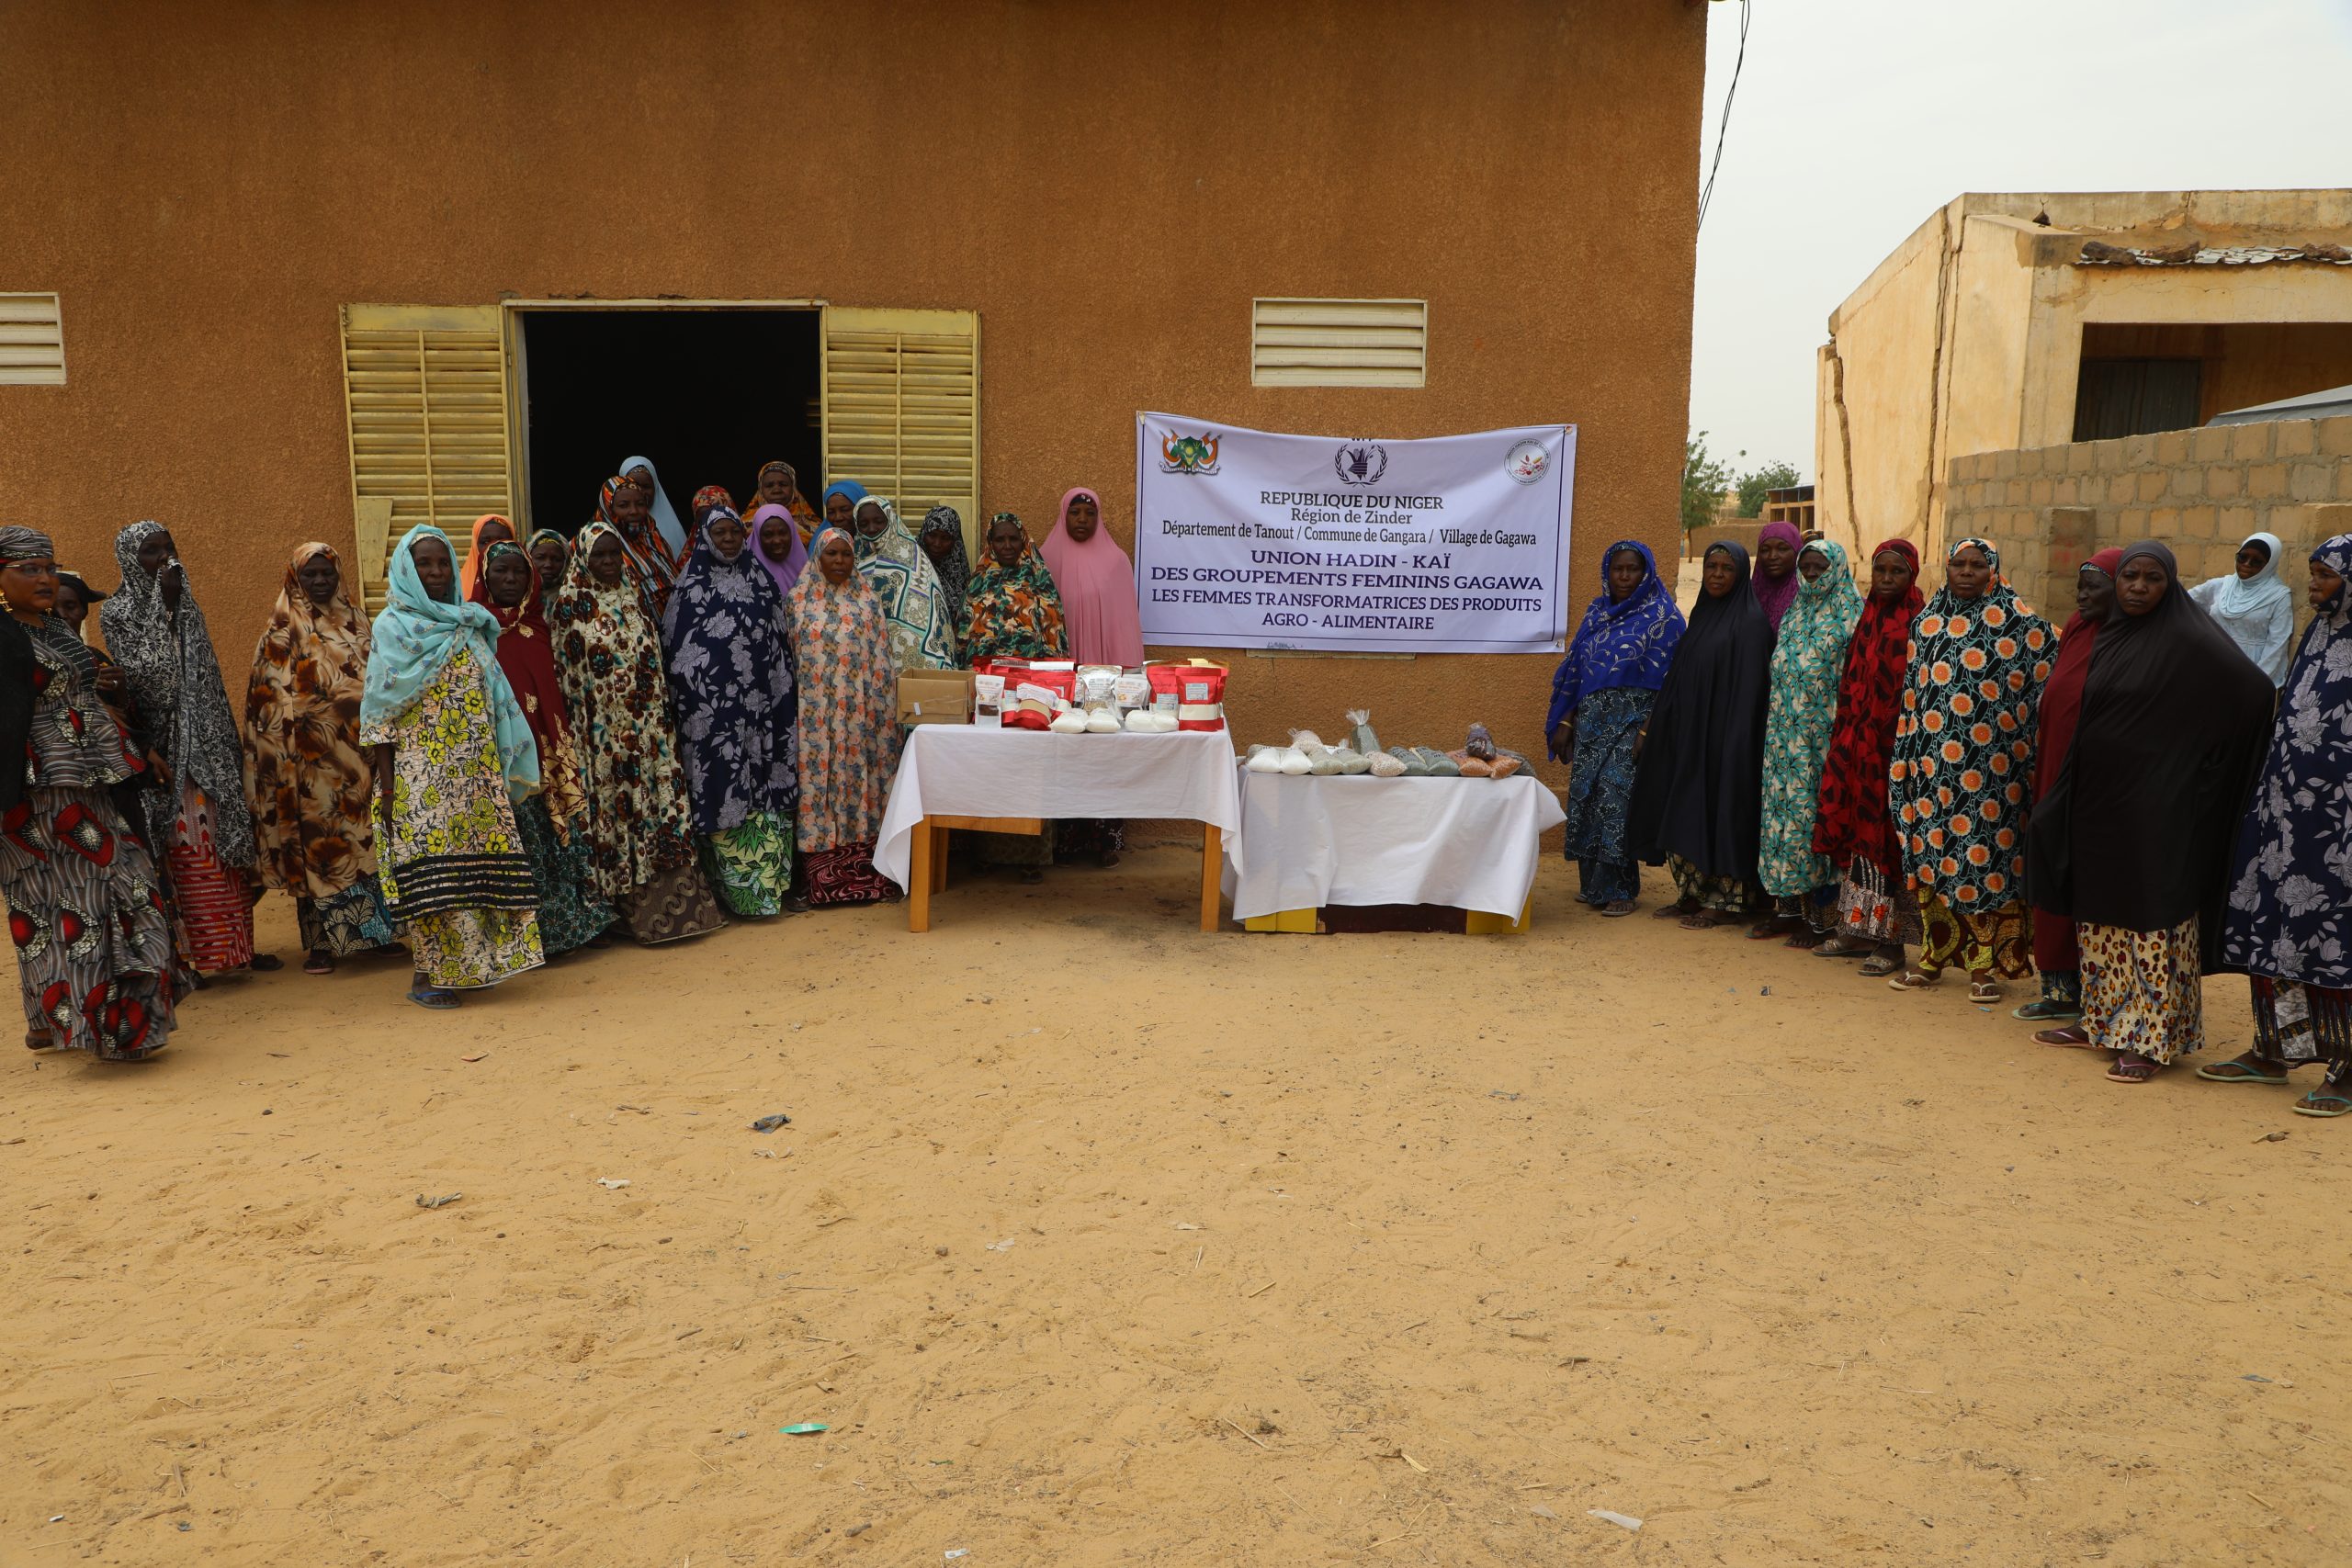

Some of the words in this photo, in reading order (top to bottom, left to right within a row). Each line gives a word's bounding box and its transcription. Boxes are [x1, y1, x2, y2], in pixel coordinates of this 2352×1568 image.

[1261, 491, 1363, 509] REPUBLIQUE
[1366, 495, 1390, 508] DU
[1395, 496, 1443, 509] NIGER
[1291, 508, 1340, 524] Région
[1344, 510, 1361, 523] de
[1364, 510, 1413, 524] Zinder
[1162, 520, 1236, 537] Département
[1238, 523, 1251, 537] de
[1254, 524, 1294, 539] Tanout
[1296, 525, 1302, 540] /
[1305, 526, 1362, 541] Commune
[1363, 528, 1377, 542] de
[1379, 528, 1426, 546] Gangara
[1429, 529, 1434, 544] /
[1440, 529, 1477, 547] Village
[1479, 530, 1493, 544] de
[1495, 530, 1536, 547] Gagawa
[1250, 550, 1322, 565] UNION
[1326, 553, 1396, 568] HADIN
[1412, 553, 1451, 569] KAÏ
[1151, 567, 1189, 581] DES
[1193, 568, 1347, 587] GROUPEMENTS
[1351, 573, 1450, 589] FEMININS
[1453, 576, 1544, 590] GAGAWA
[1152, 589, 1179, 602] LES
[1182, 590, 1251, 604] FEMMES
[1255, 592, 1426, 610] TRANSFORMATRICES
[1430, 597, 1459, 610] DES
[1462, 597, 1542, 612] PRODUITS
[1261, 613, 1308, 626] AGRO
[1321, 615, 1434, 630] ALIMENTAIRE
